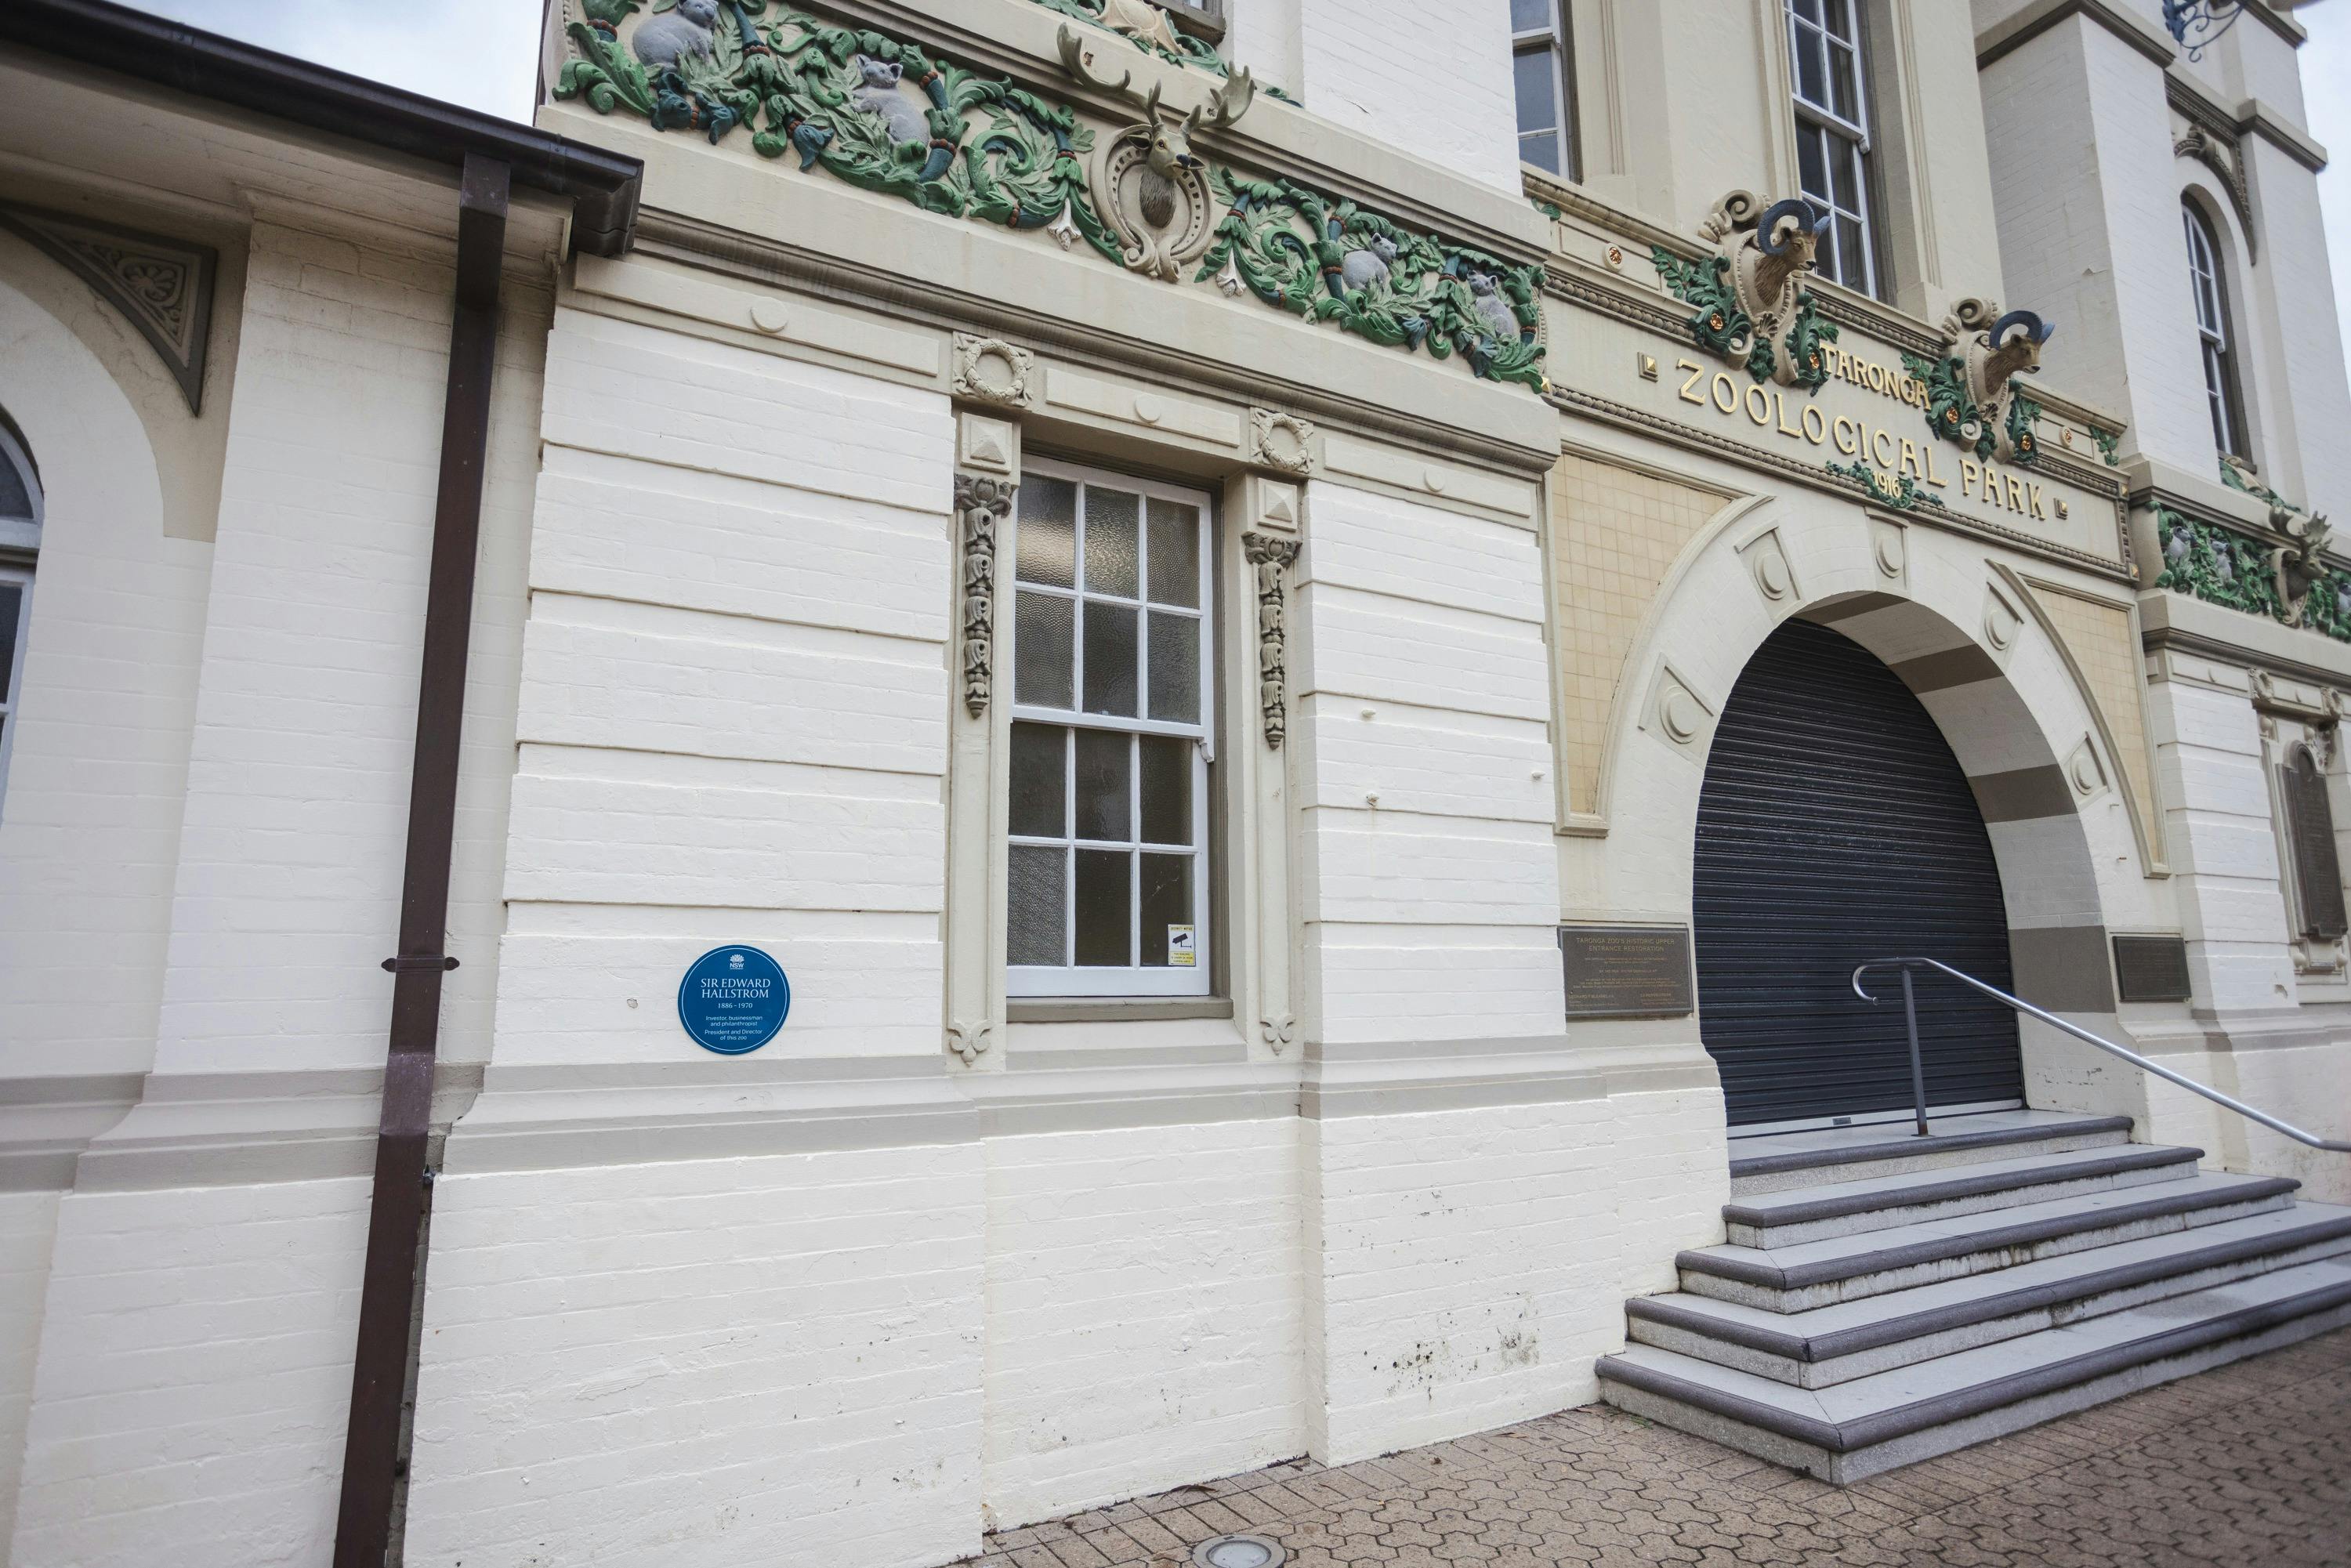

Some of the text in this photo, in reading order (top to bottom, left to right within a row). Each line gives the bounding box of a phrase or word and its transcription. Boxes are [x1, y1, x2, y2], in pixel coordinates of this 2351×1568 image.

[1820, 342, 1931, 412] TARONGA
[1676, 358, 2046, 521] ZOOLOGICAL PARK
[1873, 470, 1903, 498] 1916
[701, 979, 770, 988] SIR EDWARD
[701, 989, 769, 998] HALLSTROM
